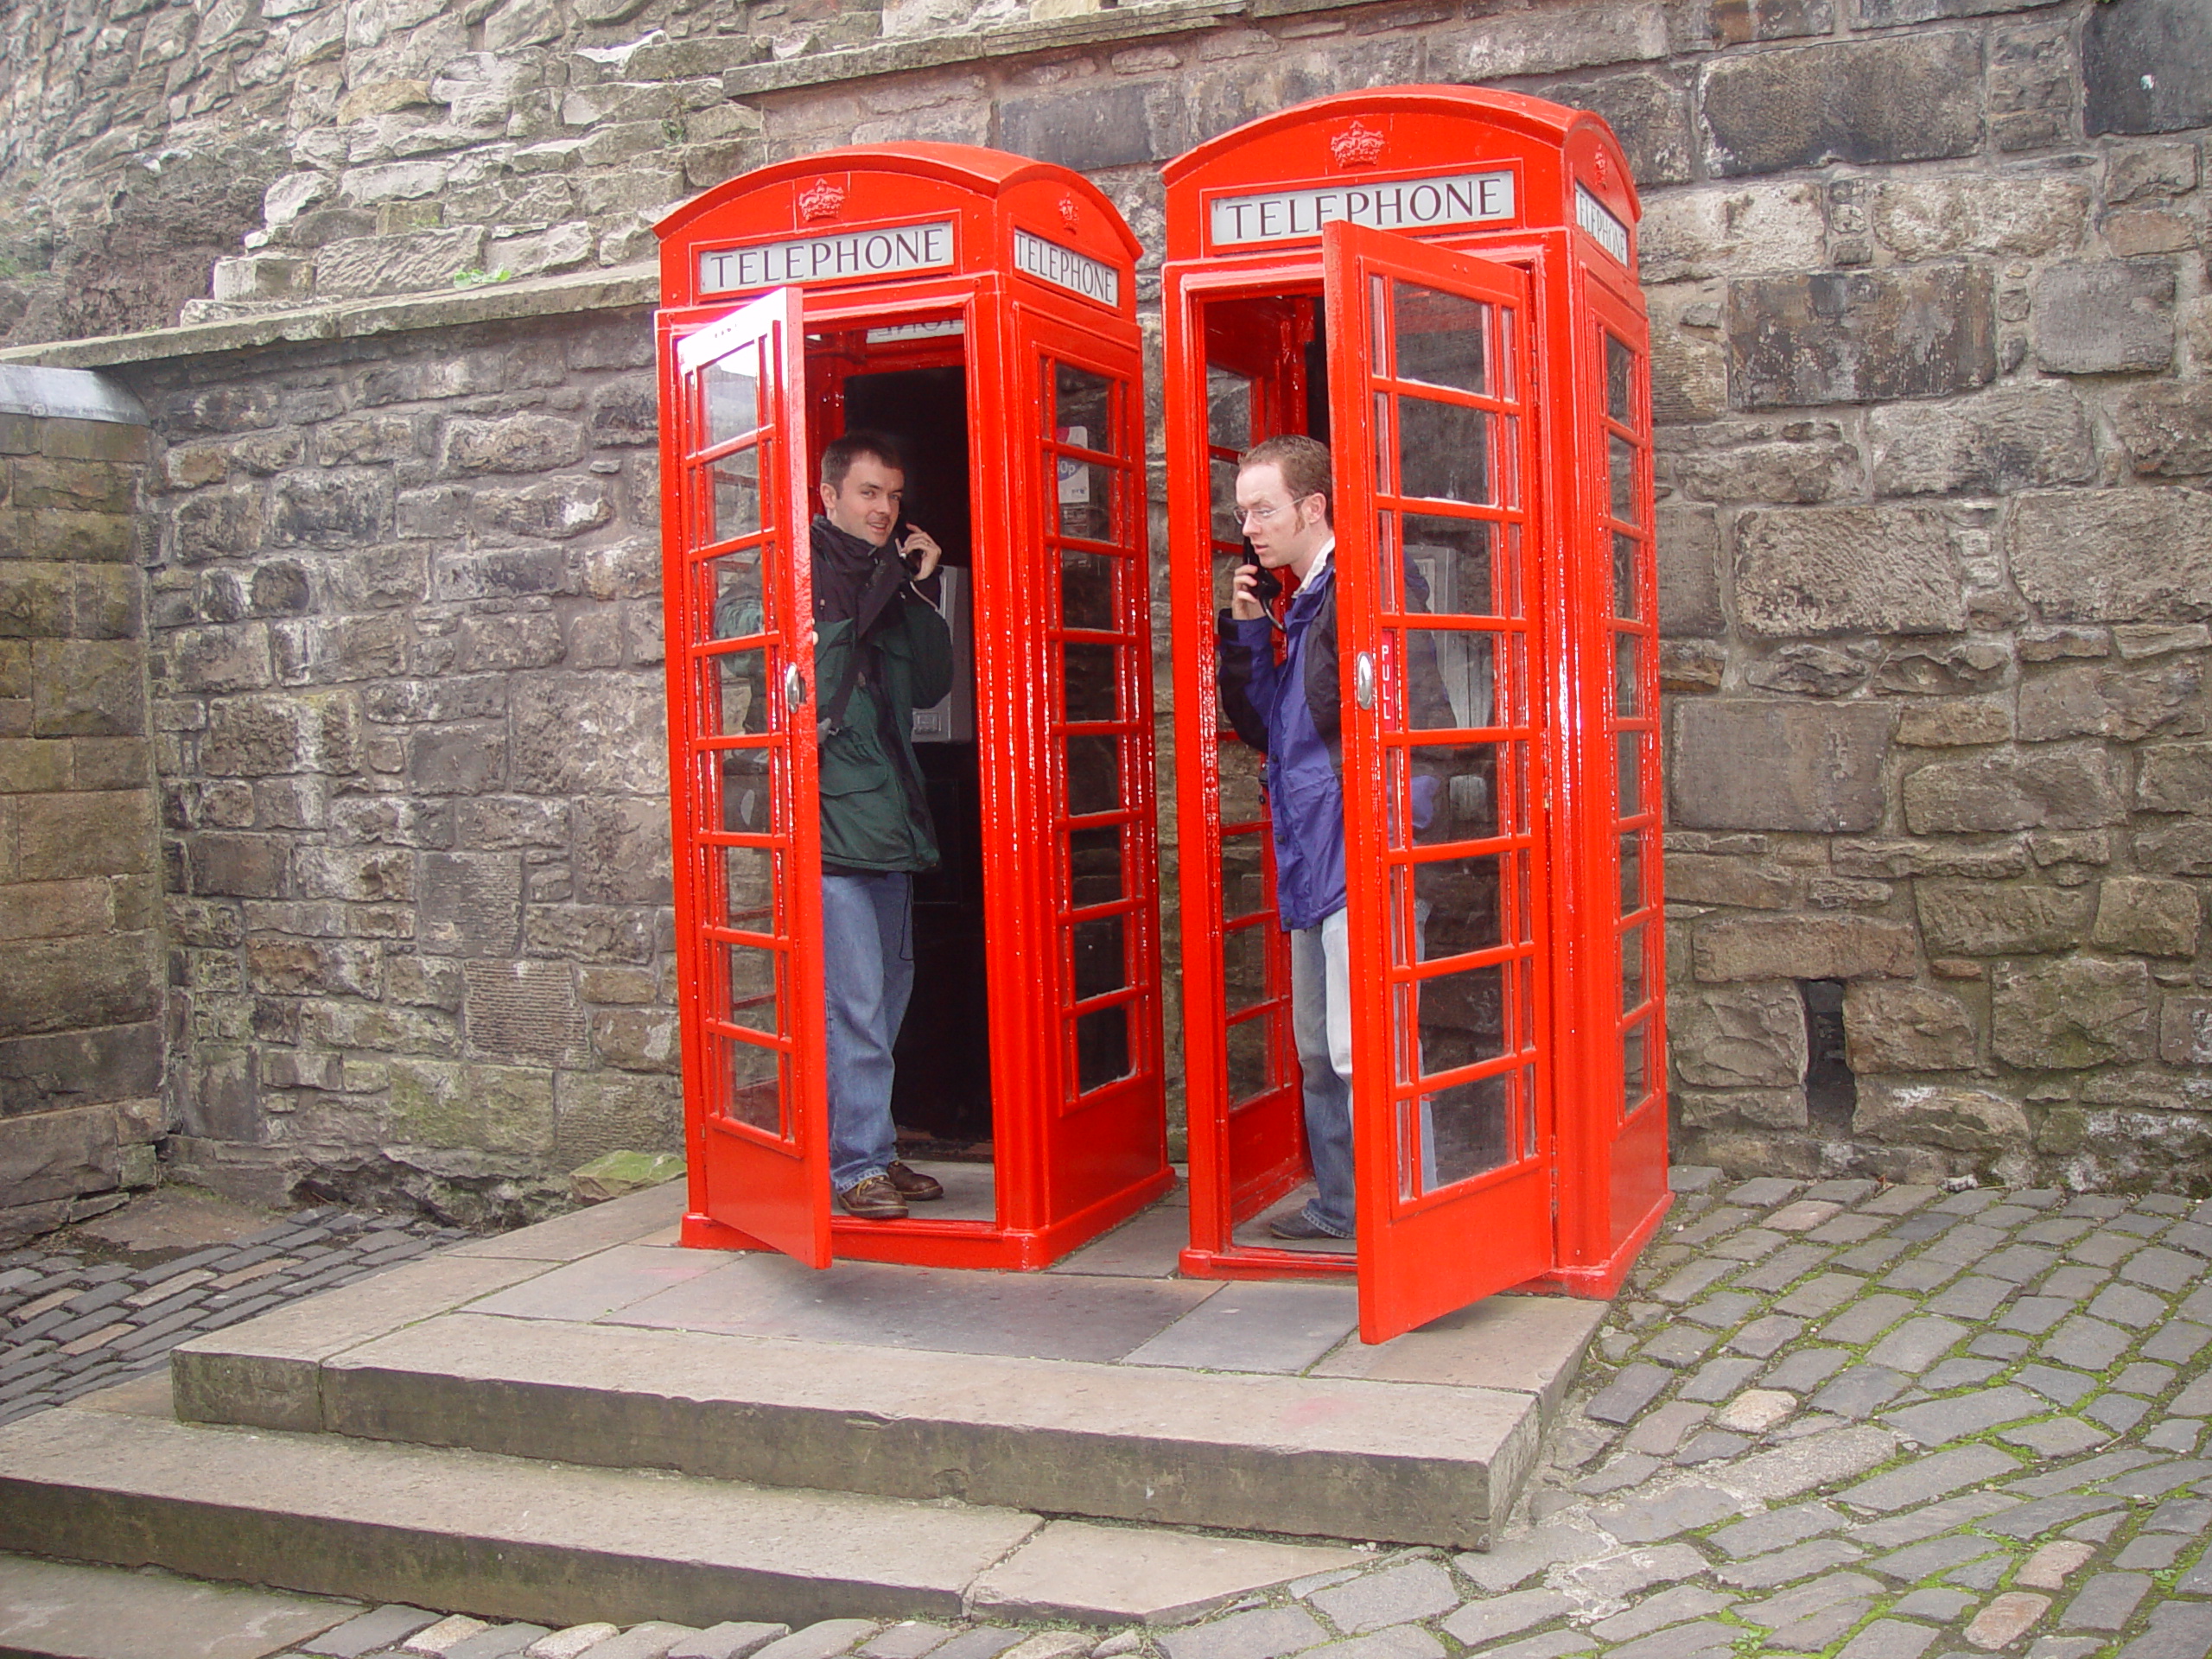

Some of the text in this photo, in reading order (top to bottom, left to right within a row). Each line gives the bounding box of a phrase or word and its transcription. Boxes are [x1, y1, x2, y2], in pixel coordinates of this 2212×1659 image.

[1225, 179, 1501, 239] TELEPHONE
[1574, 189, 1624, 261] ELEPHONE
[710, 228, 943, 288] TELEPHONE
[1015, 232, 1112, 303] TELEPHONE
[1058, 461, 1076, 476] 0p
[1382, 645, 1390, 719] PULL
